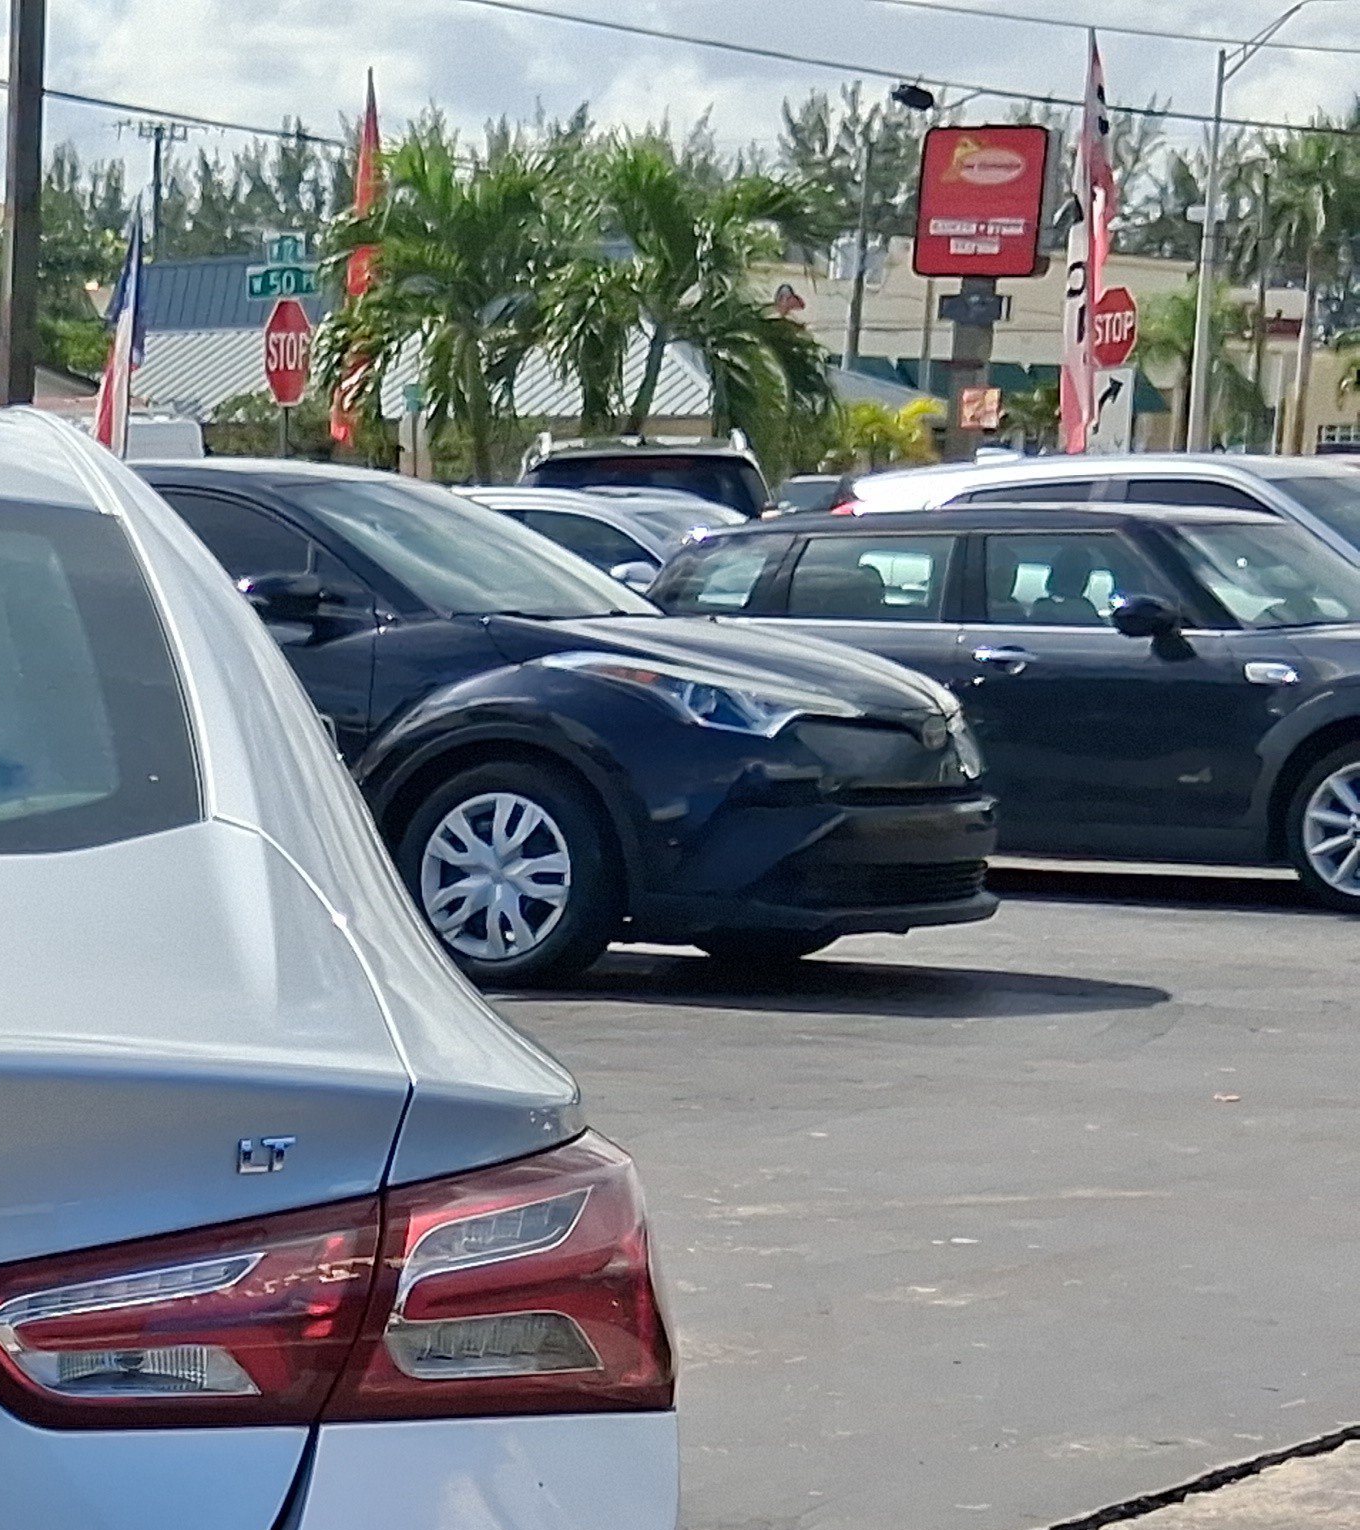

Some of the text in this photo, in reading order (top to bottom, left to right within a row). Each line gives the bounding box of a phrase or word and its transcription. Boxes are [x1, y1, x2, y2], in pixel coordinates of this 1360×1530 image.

[268, 269, 296, 295] 50
[1094, 310, 1135, 346] STOP
[267, 331, 311, 372] STOP
[236, 1134, 297, 1175] LT
